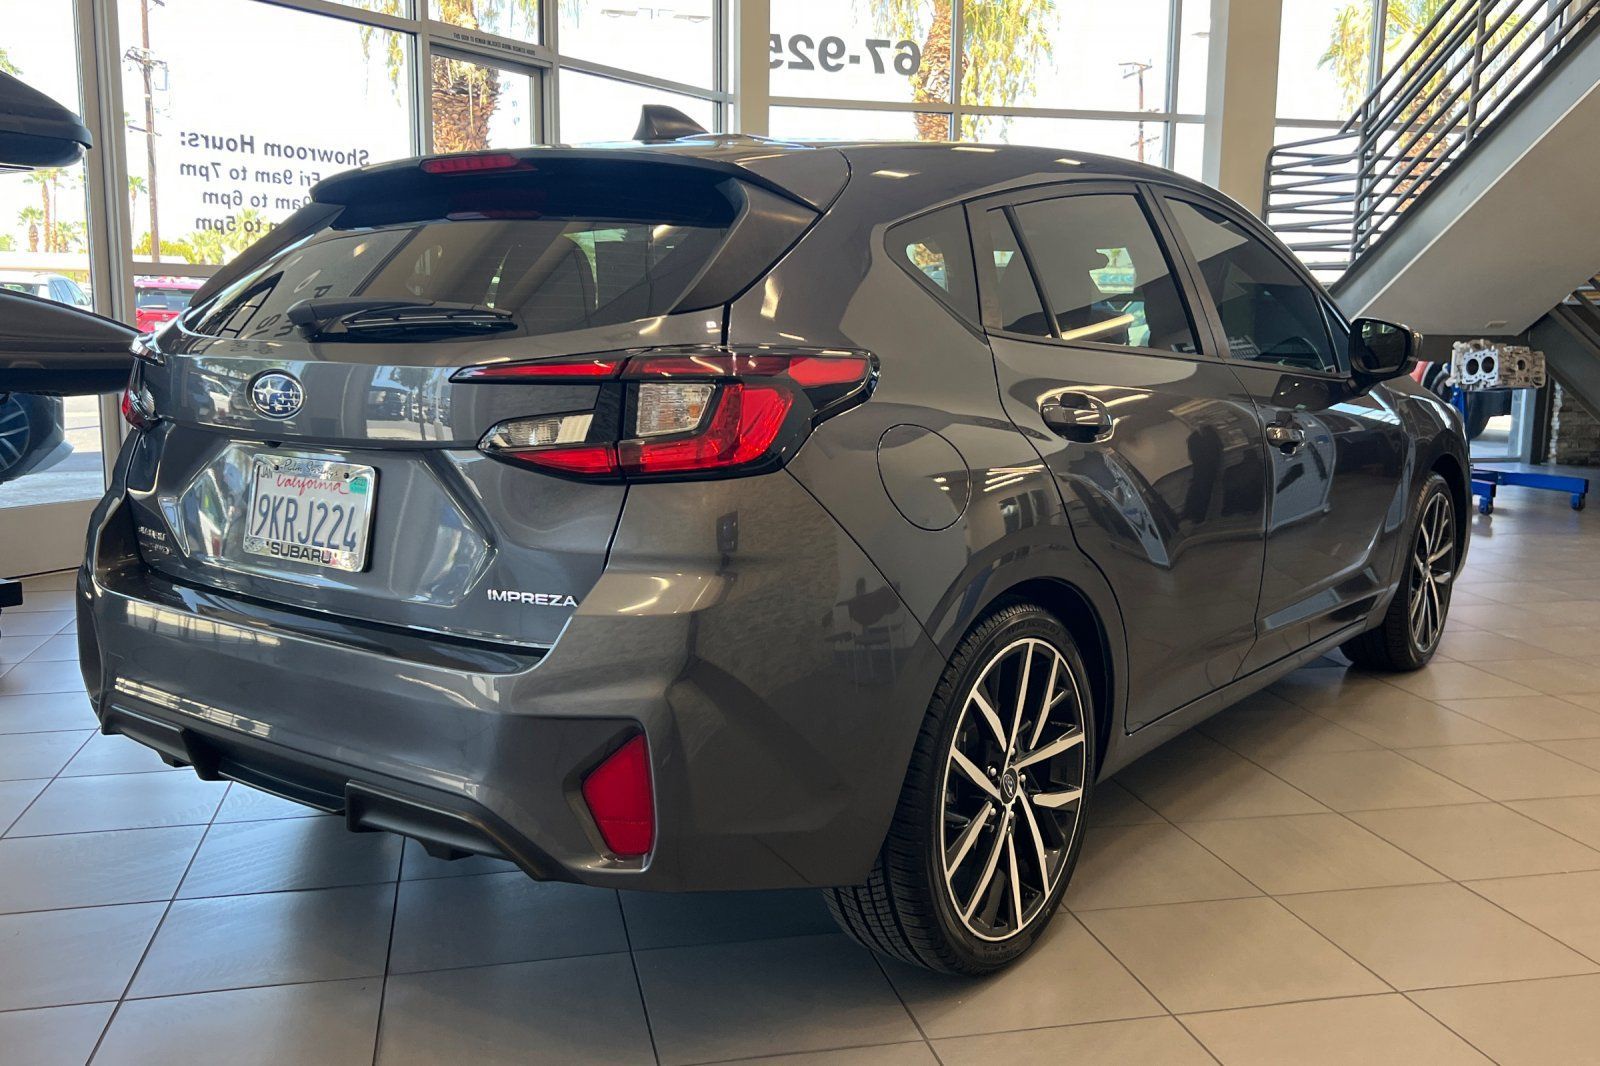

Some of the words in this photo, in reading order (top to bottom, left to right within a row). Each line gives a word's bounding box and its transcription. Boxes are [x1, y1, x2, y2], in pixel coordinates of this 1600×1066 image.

[260, 467, 273, 479] JAN
[276, 474, 350, 496] California
[255, 494, 356, 553] 9KRJ224
[270, 541, 331, 564] SUBARU
[487, 589, 578, 608] IMPREZA
